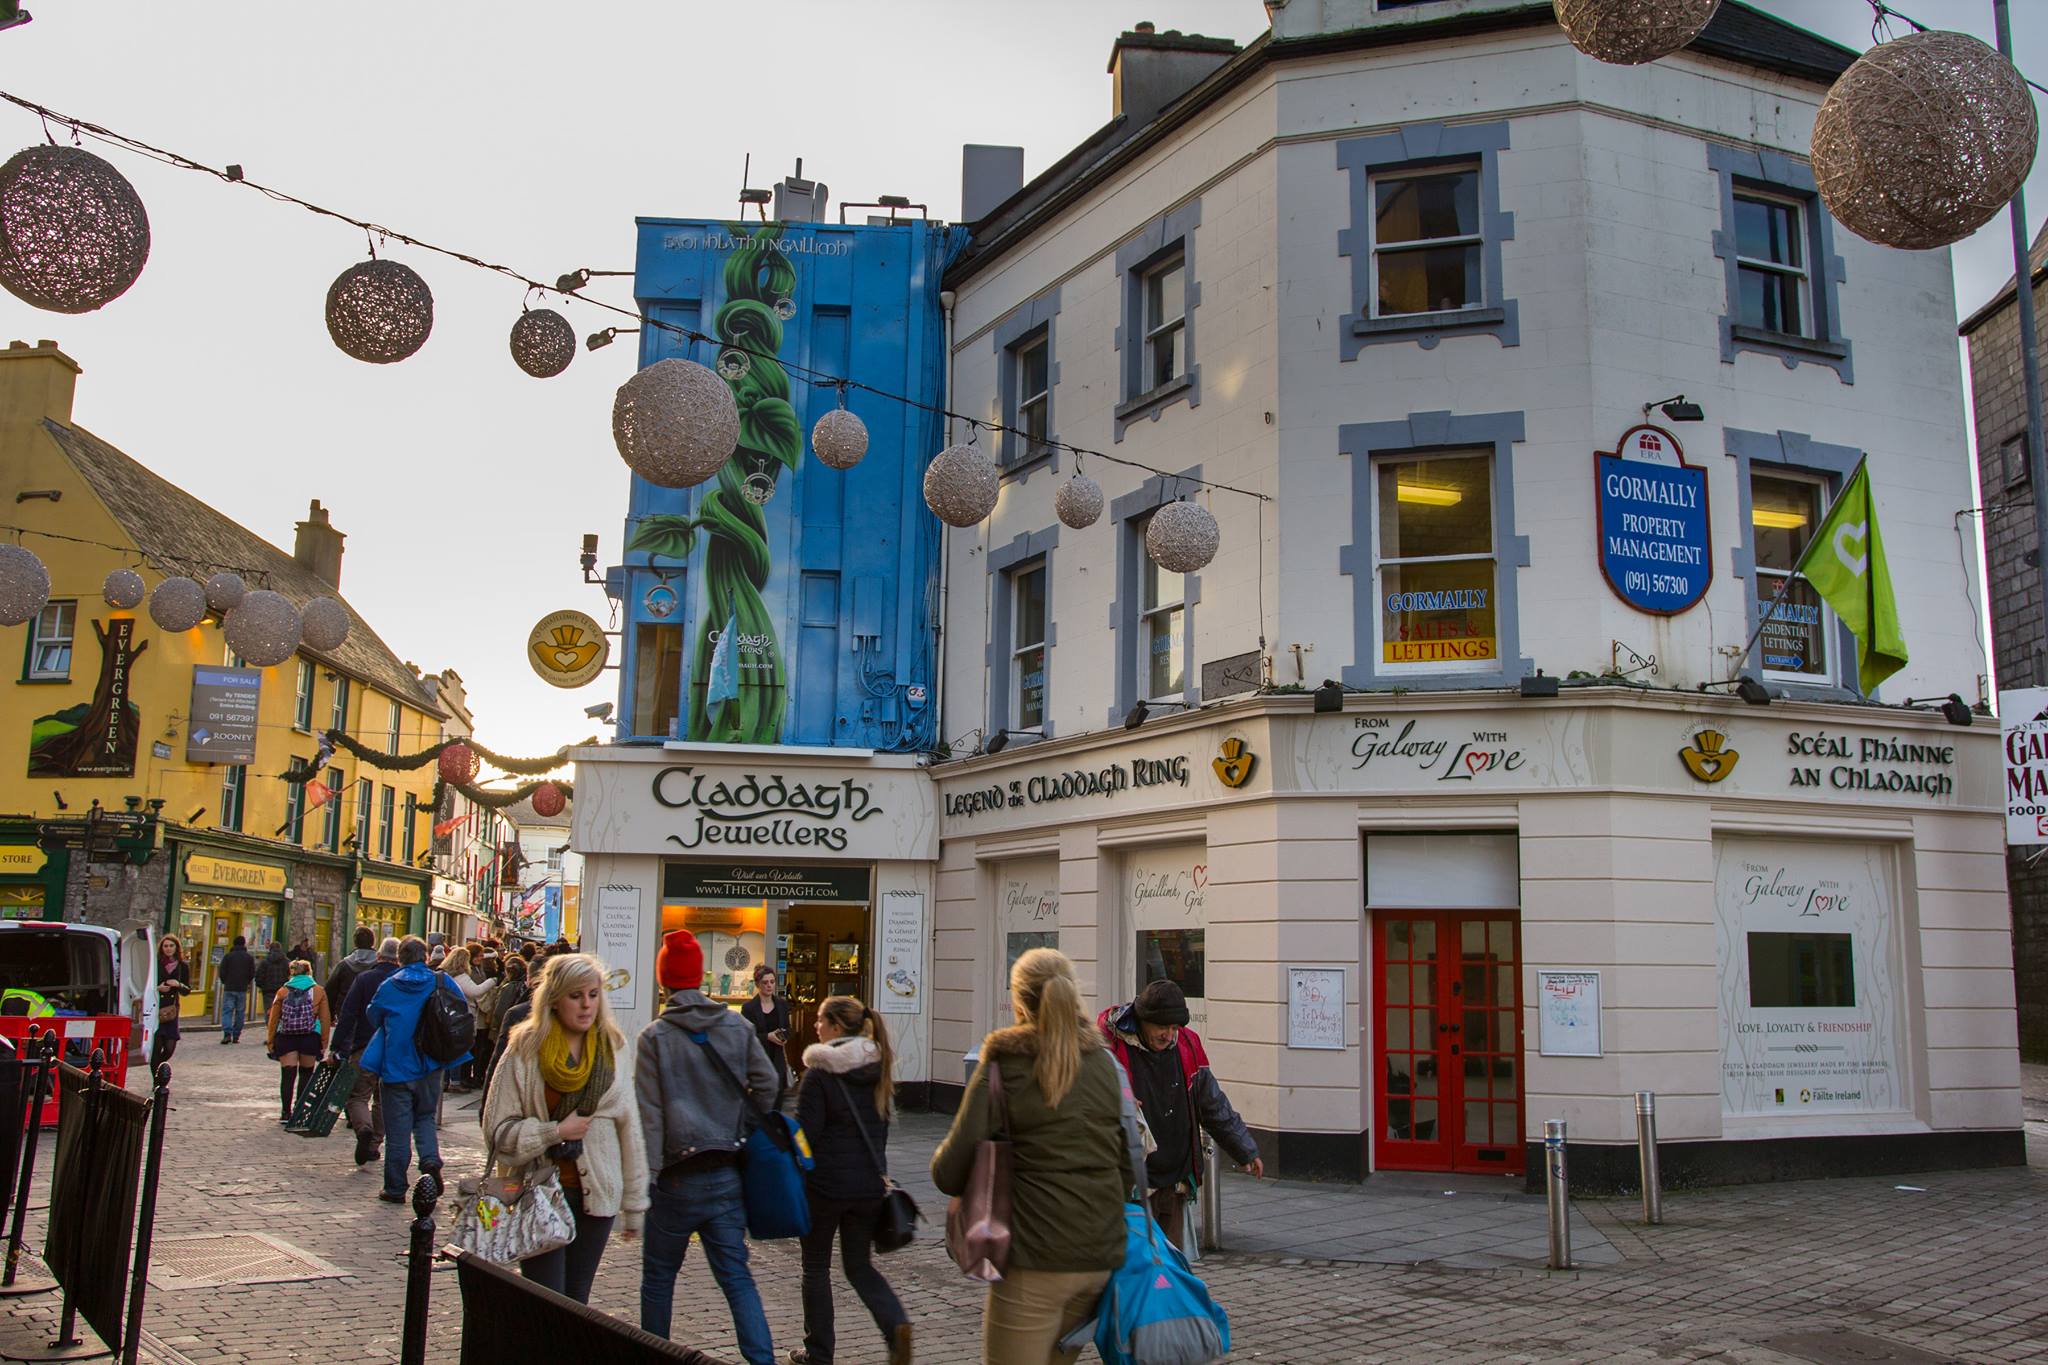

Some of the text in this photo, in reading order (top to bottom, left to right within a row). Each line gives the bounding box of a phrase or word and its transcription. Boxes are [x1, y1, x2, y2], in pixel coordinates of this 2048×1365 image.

[1640, 450, 1662, 460] ERA
[1607, 474, 1697, 508] GORMALLY
[1622, 513, 1686, 538] PROPERTY
[1609, 536, 1701, 565] MANAGEMENT
[1625, 570, 1688, 596] (091) 567300
[1388, 589, 1487, 612] GORMALLY
[1400, 622, 1458, 640] SALES
[1392, 640, 1489, 660] LETTINGS
[1764, 637, 1803, 651] LETTINGS
[105, 624, 128, 753] EVERGREEN
[239, 677, 256, 685] SALE
[1355, 718, 1390, 728] FROM
[213, 733, 252, 742] ROONEY
[1351, 720, 1447, 770] Galway
[1473, 732, 1507, 743] WITH
[2008, 806, 2046, 816] FOOD
[666, 816, 848, 851] Jewellers
[2, 855, 33, 863] STORE
[1746, 863, 1769, 873] FROM
[213, 863, 266, 885] EVERGREEN
[731, 868, 754, 880] Visit
[769, 869, 803, 880] Website
[1745, 867, 1804, 907] Galway
[1007, 883, 1037, 913] Galway
[1767, 1023, 1805, 1033] LOYALTY
[1807, 1023, 1816, 1033] &
[1817, 1022, 1872, 1033] FRIENDSHIP
[1835, 1090, 1861, 1100] Ireland
